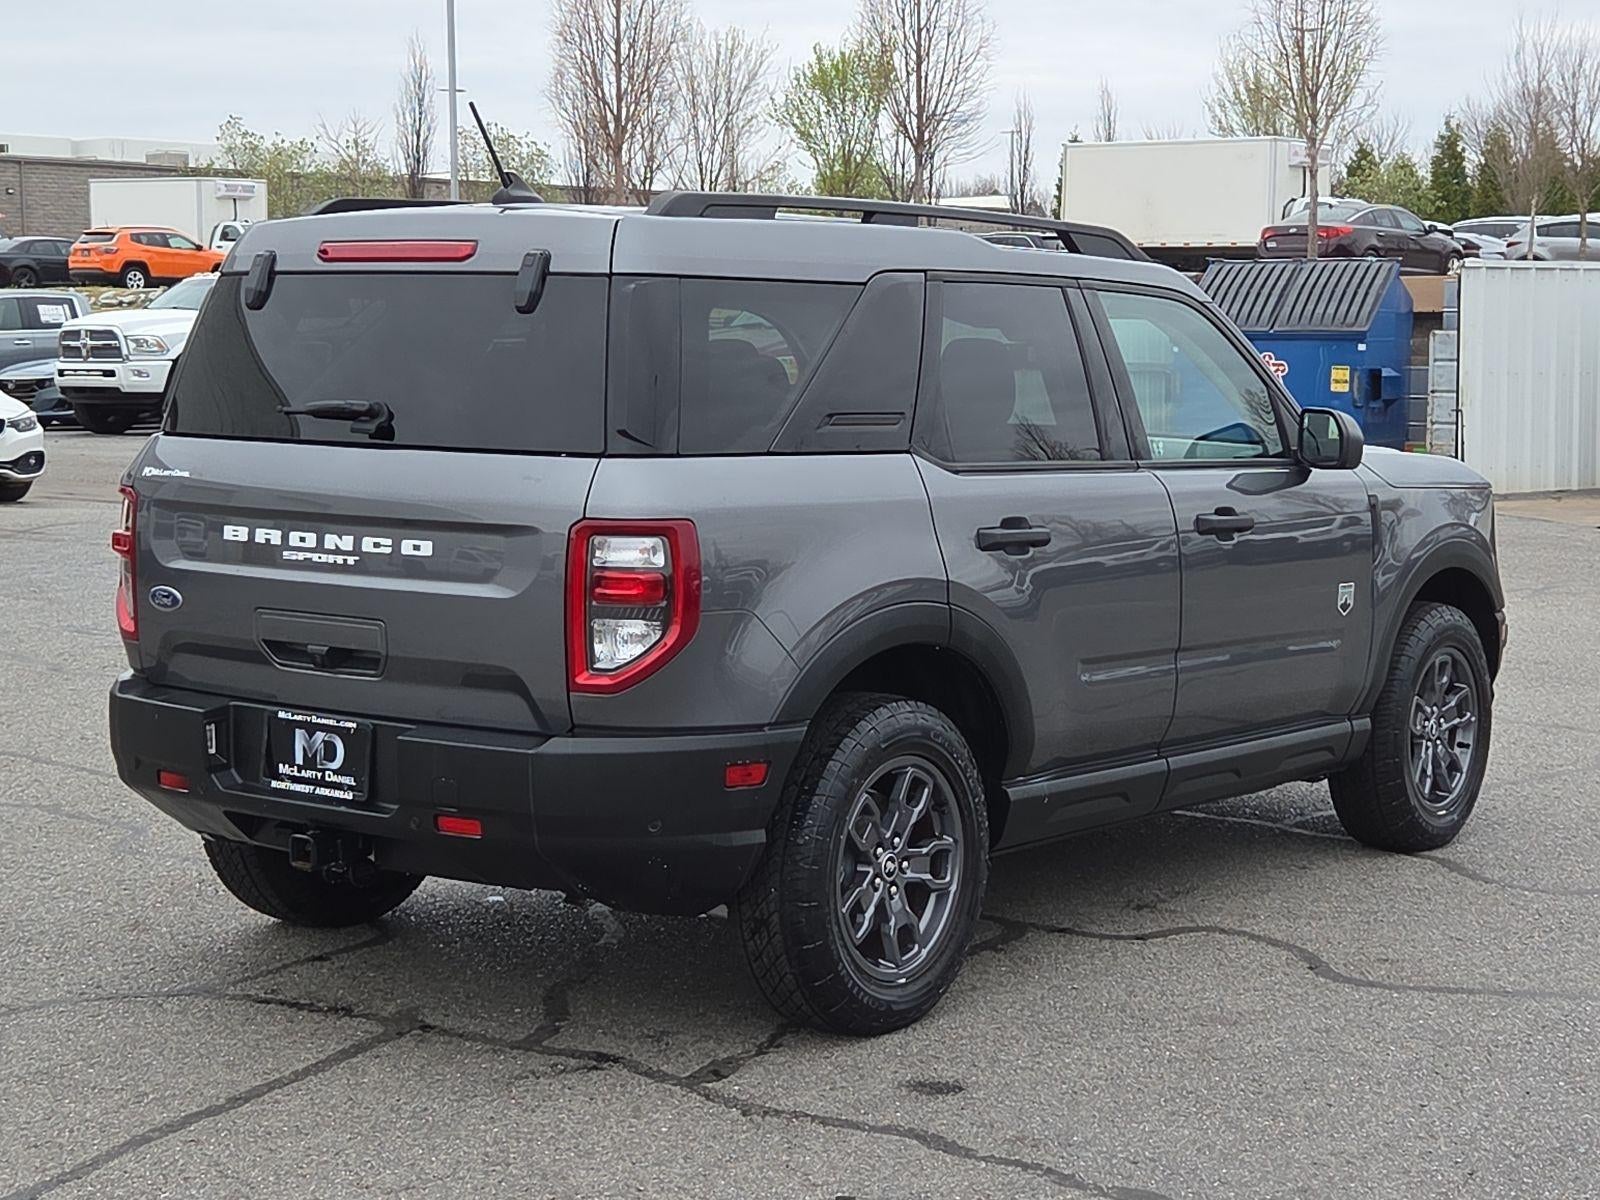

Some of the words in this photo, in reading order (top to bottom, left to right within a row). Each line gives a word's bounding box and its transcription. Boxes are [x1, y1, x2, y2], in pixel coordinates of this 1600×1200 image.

[223, 525, 433, 556] BRONCO
[282, 550, 361, 566] SPORT
[294, 728, 345, 770] MD
[325, 770, 356, 786] DANIEL
[270, 780, 314, 794] NORTHWEST
[314, 787, 353, 800] ARKANSAS
